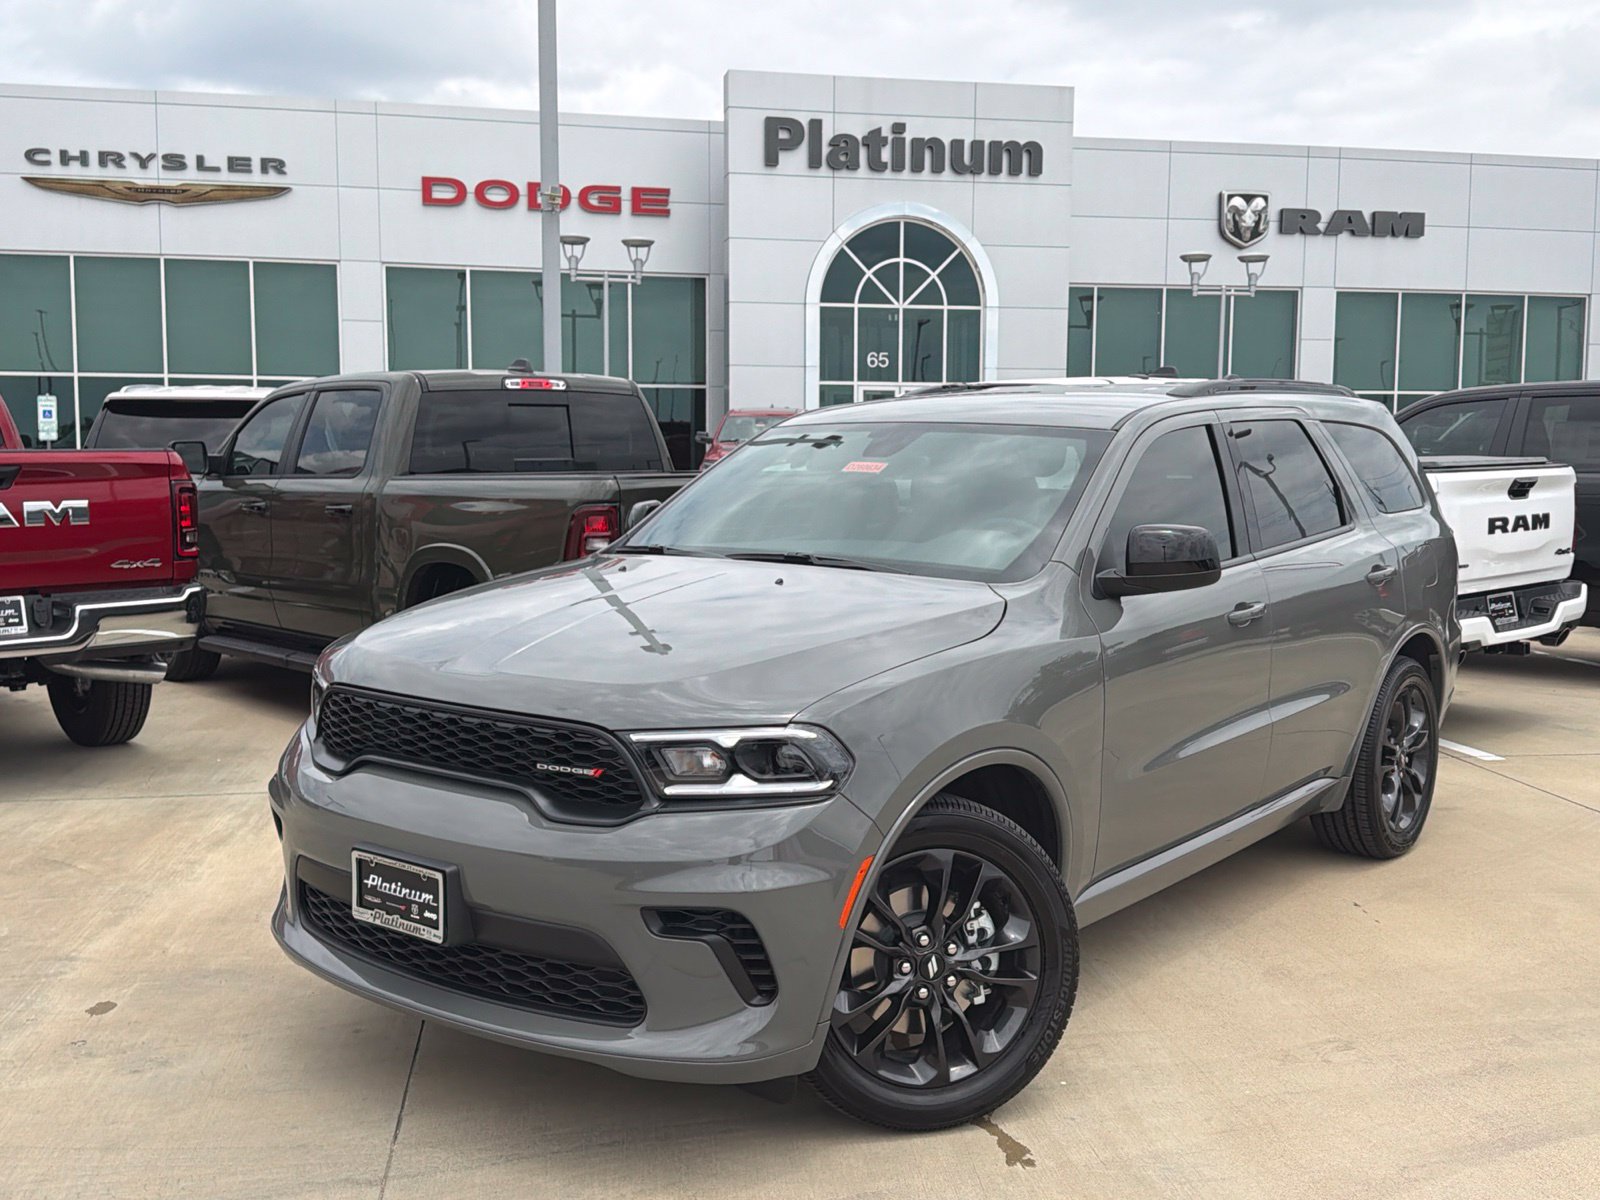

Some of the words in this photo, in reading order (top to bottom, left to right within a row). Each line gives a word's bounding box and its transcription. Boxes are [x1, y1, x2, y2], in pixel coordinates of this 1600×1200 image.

[24, 147, 288, 175] CHRYSLER
[763, 115, 1044, 177] Platinum
[421, 175, 671, 217] DODGE
[1279, 207, 1426, 239] RAM
[866, 351, 890, 368] 65
[1487, 511, 1551, 536] RAM
[536, 762, 594, 776] DODGE
[363, 873, 438, 907] Platinum
[373, 910, 426, 936] Platinum
[1029, 937, 1074, 1065] BRIDGESTONE
